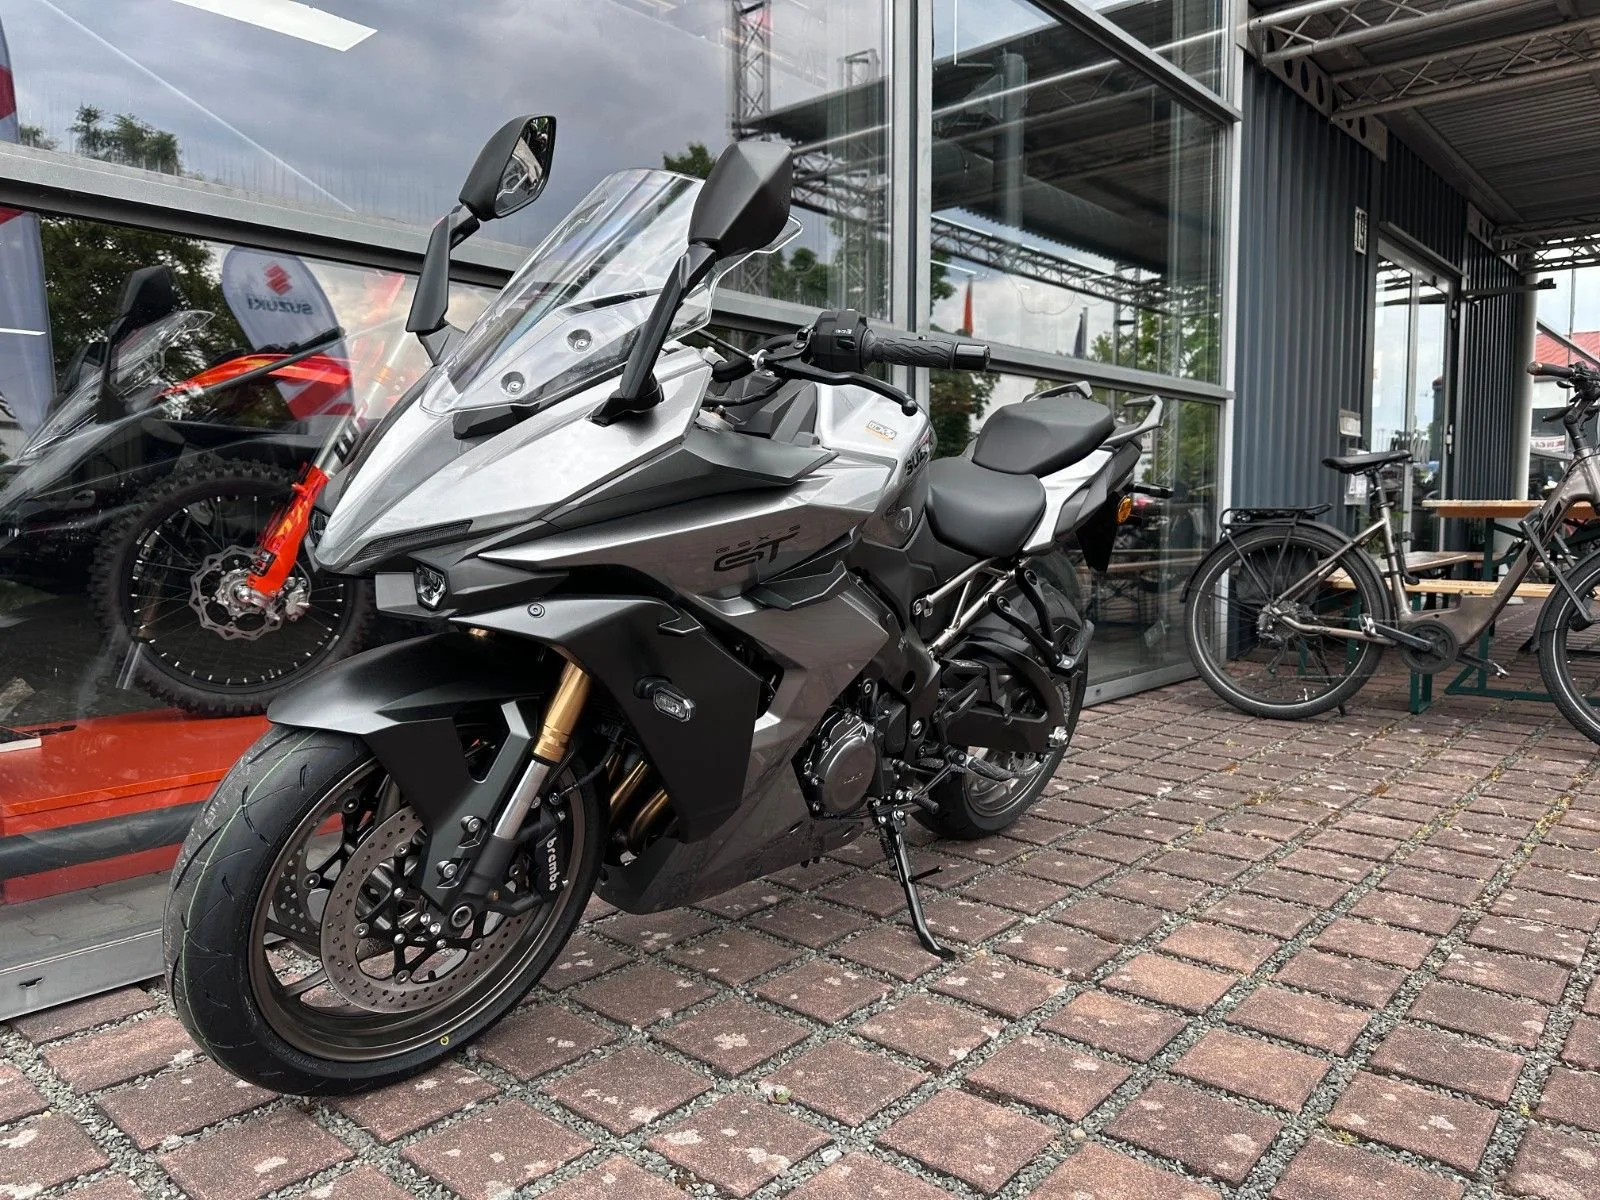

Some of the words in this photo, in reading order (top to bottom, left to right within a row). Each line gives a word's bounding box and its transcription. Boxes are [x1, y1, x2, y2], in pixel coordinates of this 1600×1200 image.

[1356, 211, 1366, 250] 19
[904, 447, 929, 476] SUZ
[713, 531, 800, 573] GT
[546, 836, 560, 891] brembo
